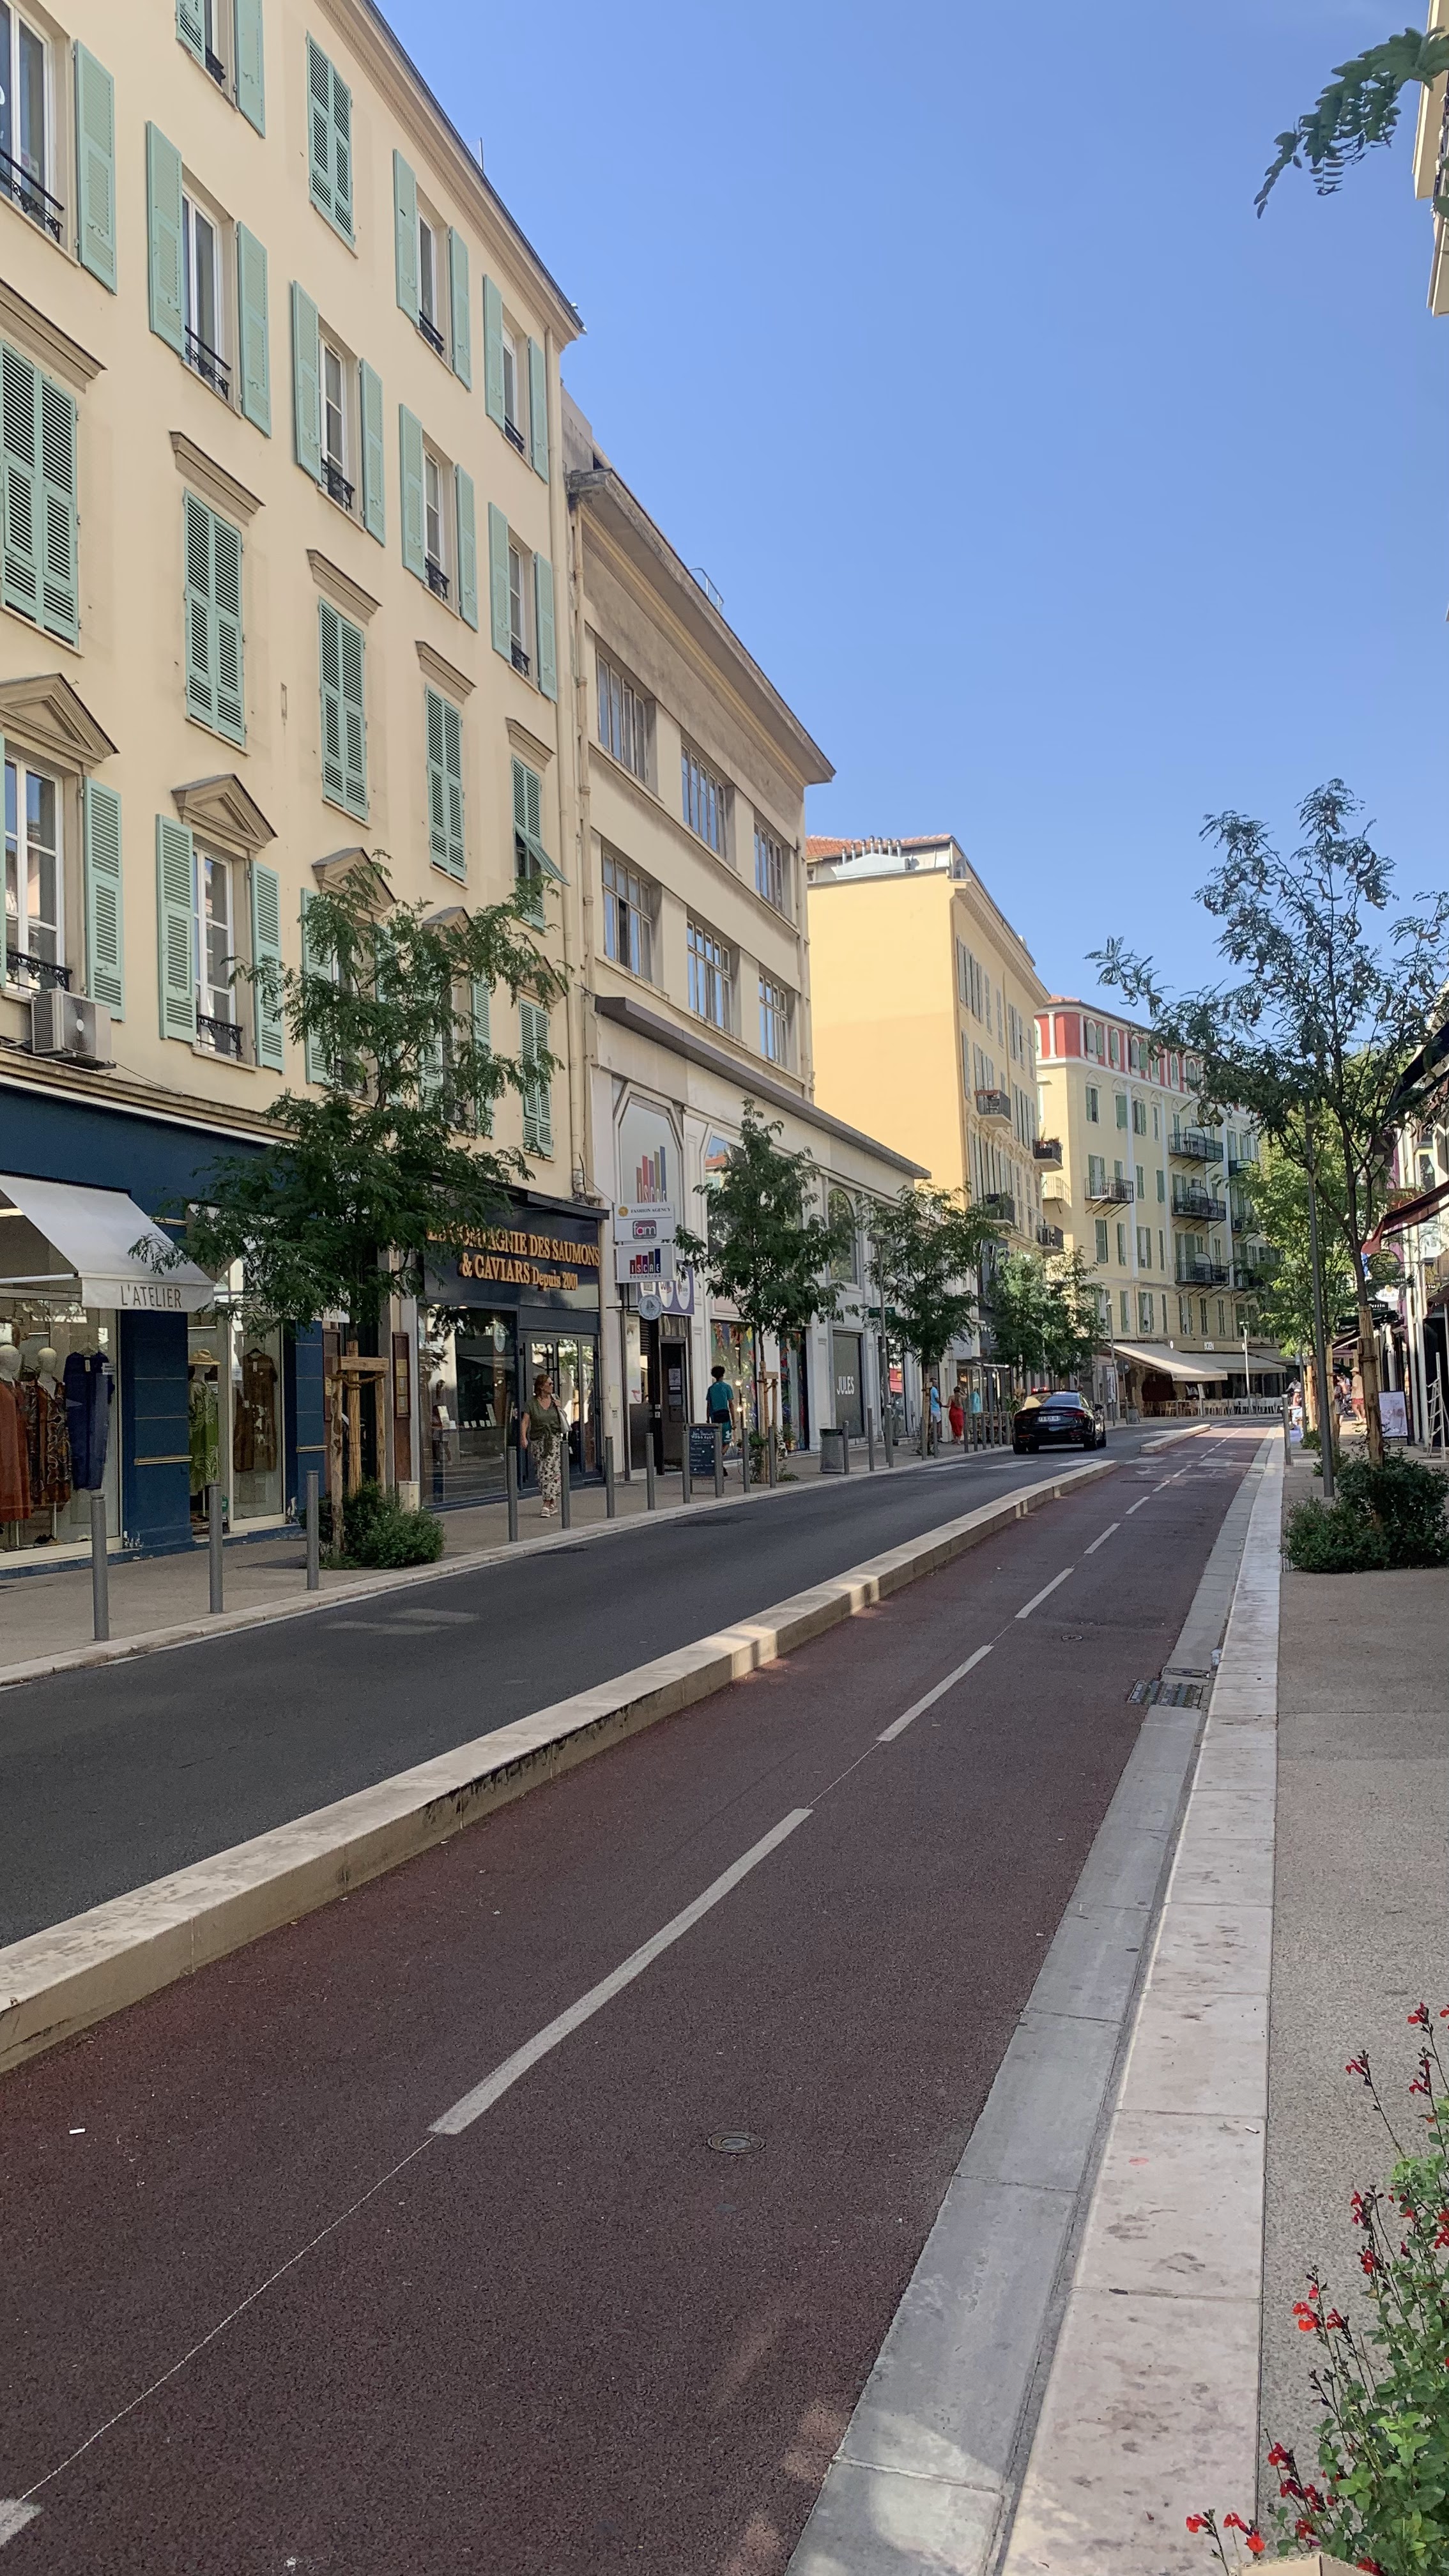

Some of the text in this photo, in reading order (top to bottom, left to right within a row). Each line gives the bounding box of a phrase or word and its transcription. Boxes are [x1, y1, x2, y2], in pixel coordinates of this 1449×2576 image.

[633, 1221, 656, 1236] fam
[529, 1234, 551, 1260] DES
[552, 1239, 600, 1267] SAUMONS
[462, 1252, 579, 1291] & CAVIARS Depuis 2001
[631, 1263, 660, 1273] ISCAE
[120, 1284, 181, 1308] L'ATELIER
[836, 1376, 855, 1395] JULES
